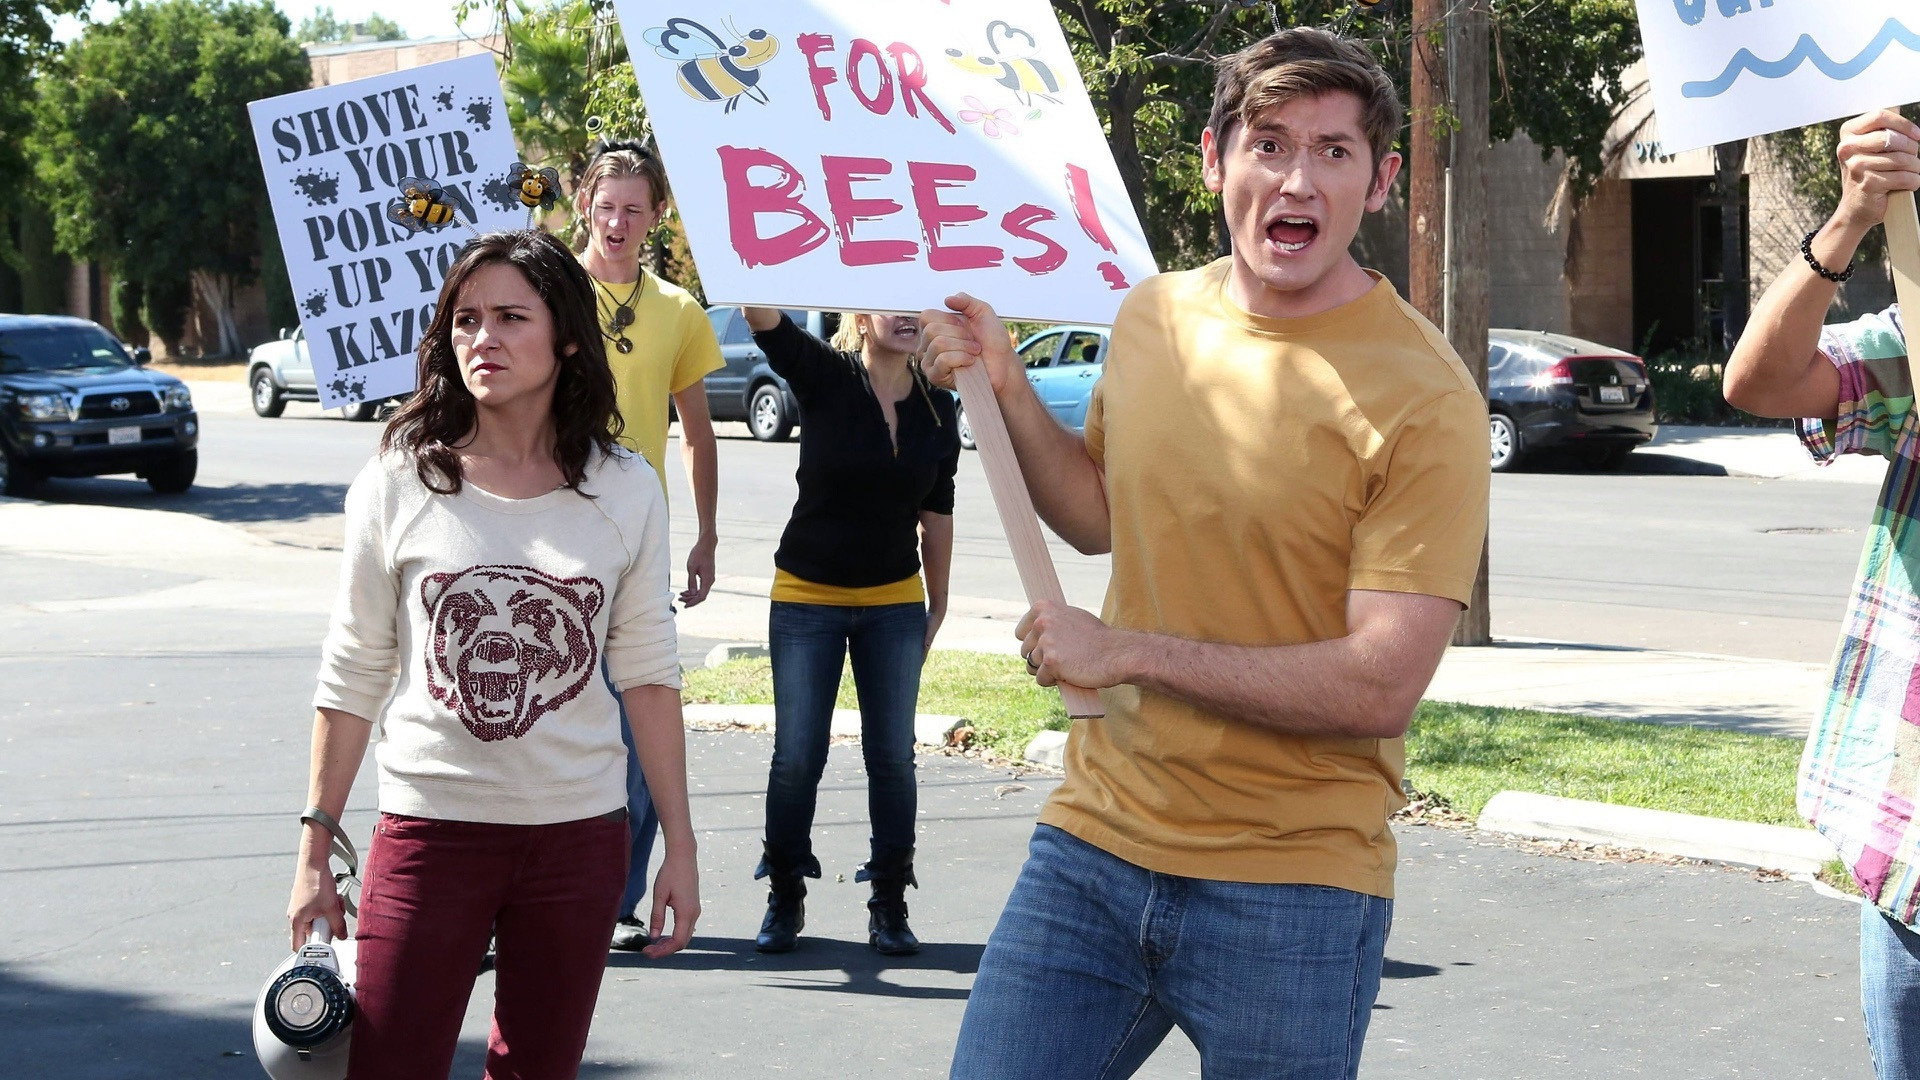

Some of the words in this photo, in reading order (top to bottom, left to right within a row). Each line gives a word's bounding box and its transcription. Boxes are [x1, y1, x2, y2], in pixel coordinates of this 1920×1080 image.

[797, 32, 957, 135] FOR
[271, 84, 428, 164] SHOVE
[344, 130, 478, 194] YOUR
[328, 256, 392, 309] UP
